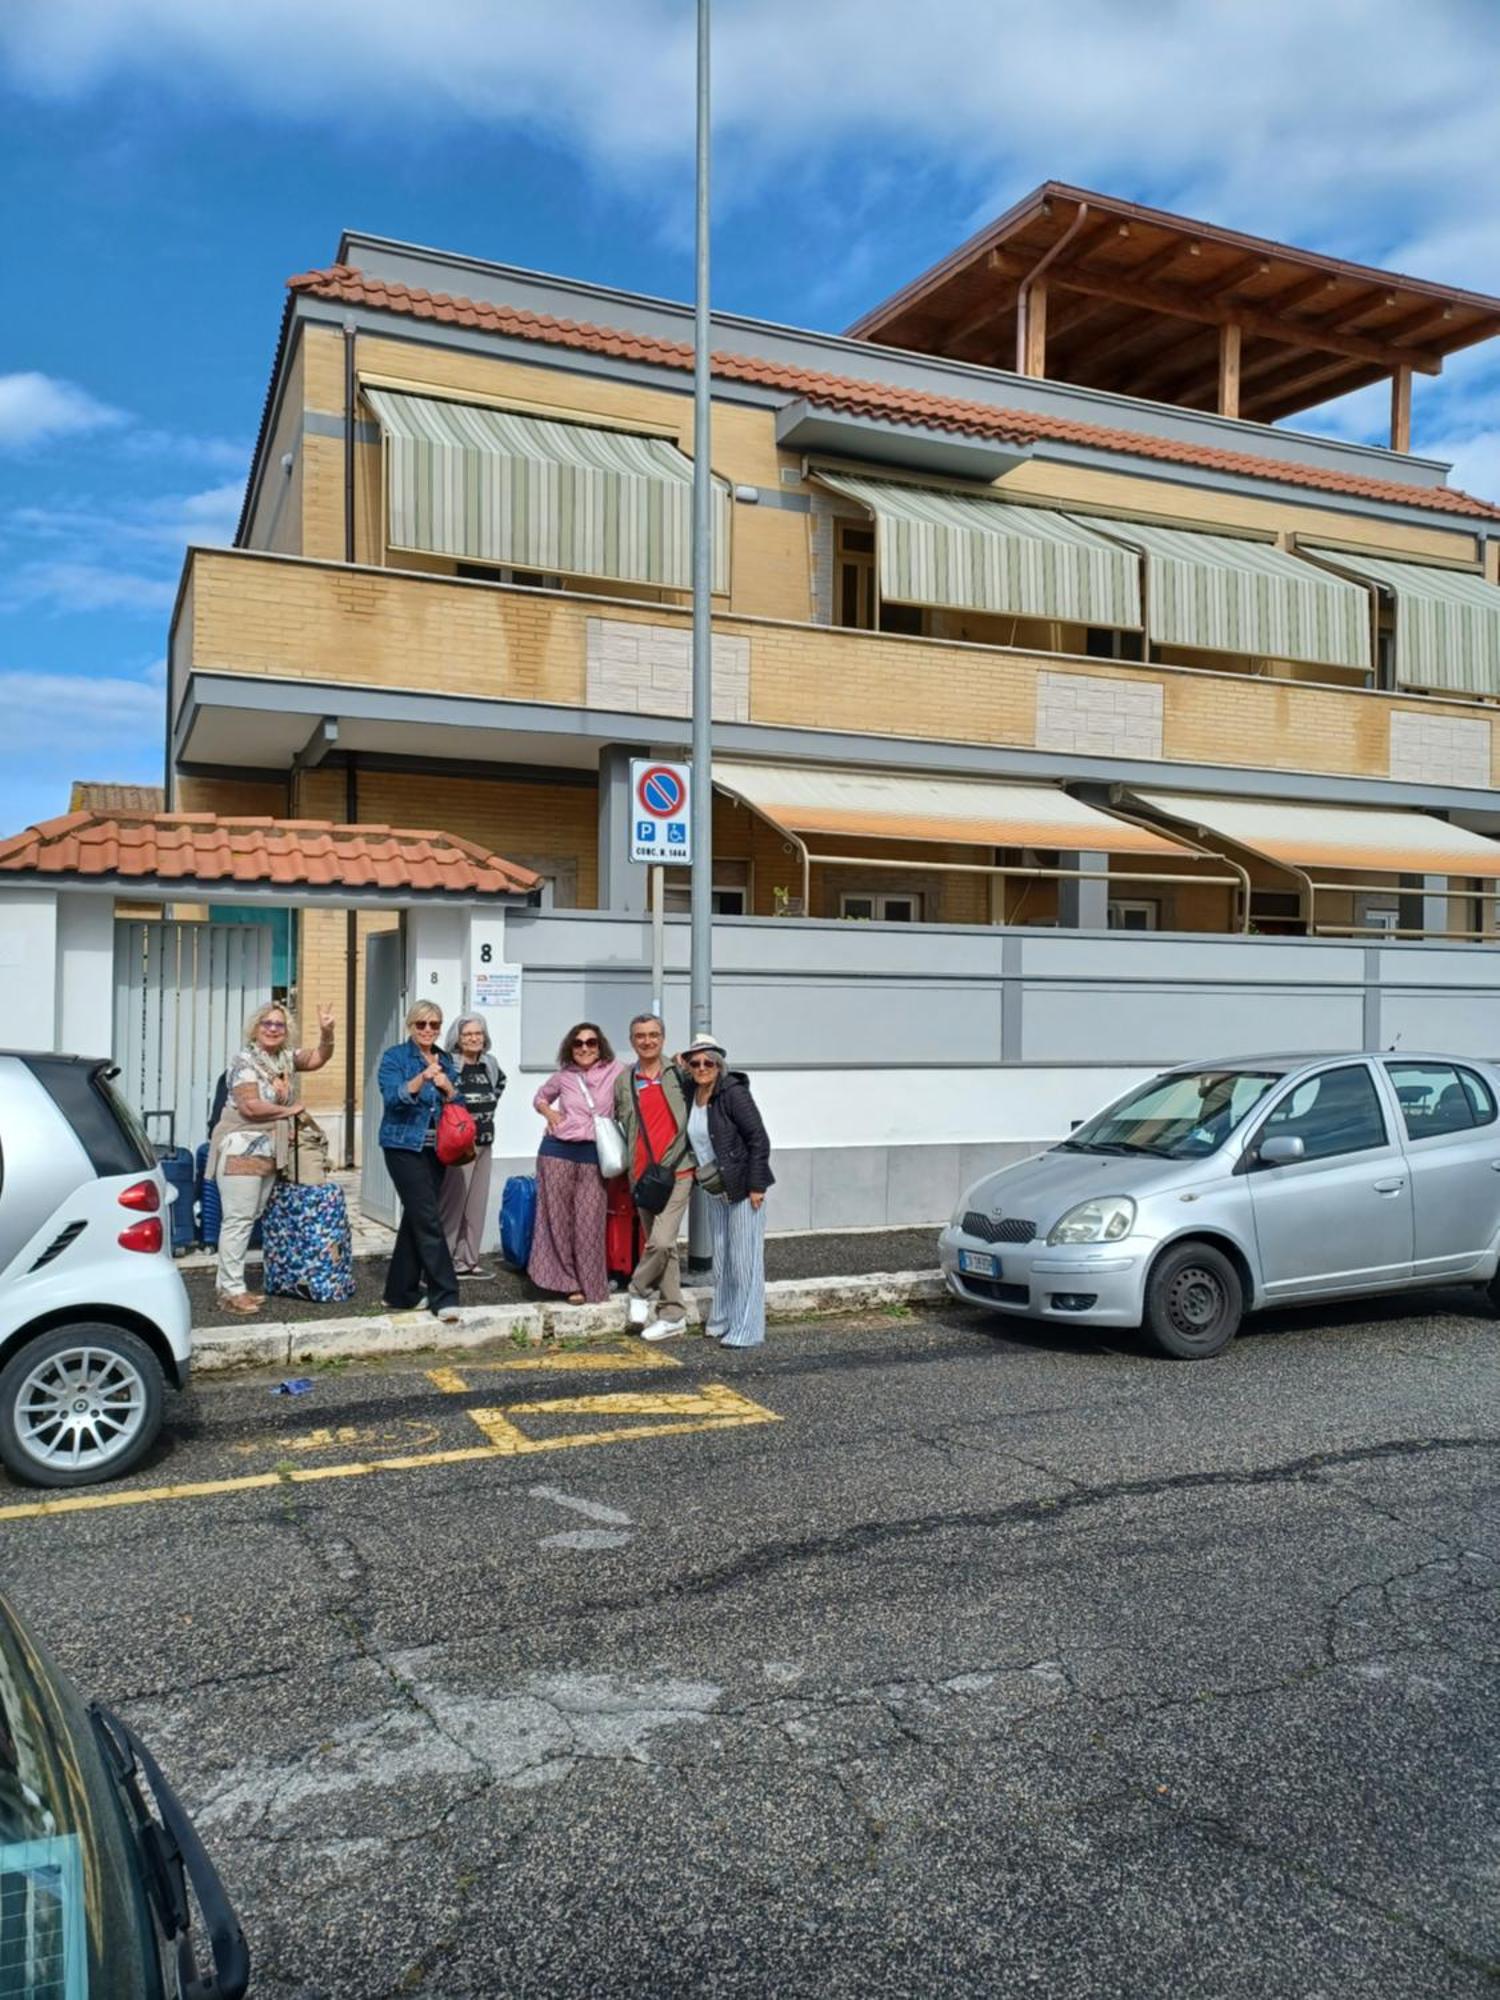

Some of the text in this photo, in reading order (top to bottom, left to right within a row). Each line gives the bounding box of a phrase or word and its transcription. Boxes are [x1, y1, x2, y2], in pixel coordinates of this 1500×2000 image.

[641, 824, 652, 839] P
[481, 943, 492, 963] 8
[430, 971, 439, 985] 8
